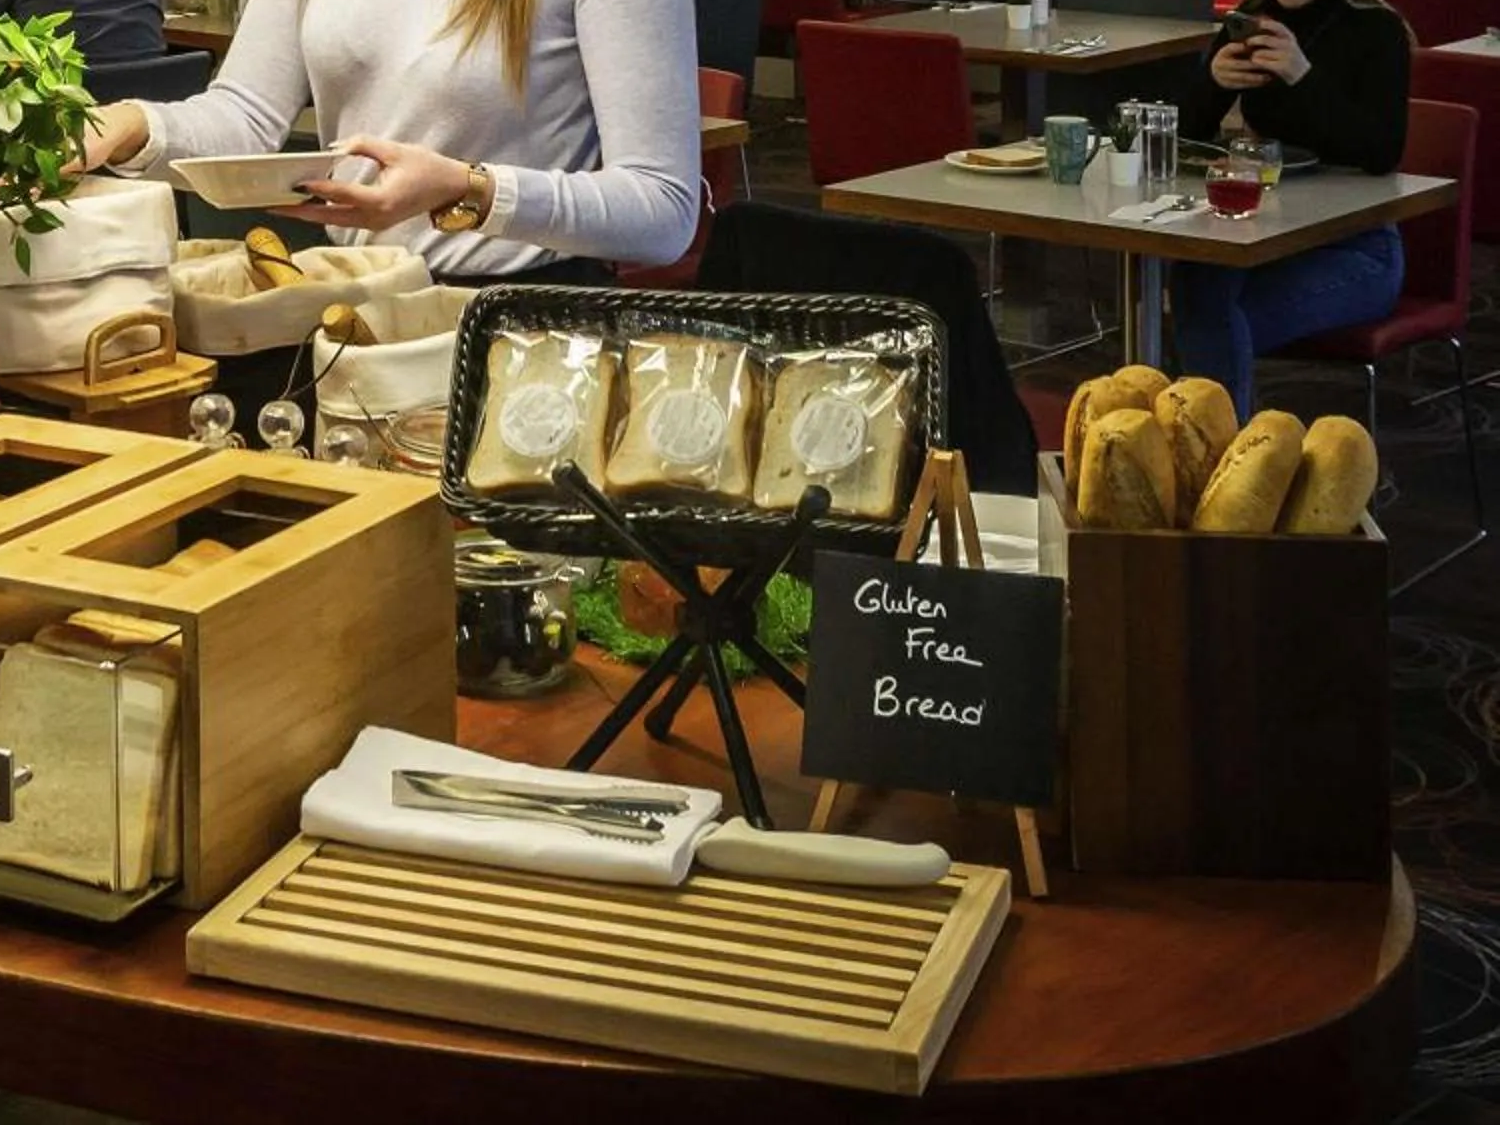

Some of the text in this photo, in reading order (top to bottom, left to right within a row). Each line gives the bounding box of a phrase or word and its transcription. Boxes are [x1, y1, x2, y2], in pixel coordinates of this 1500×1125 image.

[854, 579, 947, 619] Gluten
[906, 627, 983, 667] Free
[874, 676, 986, 725] Bread
